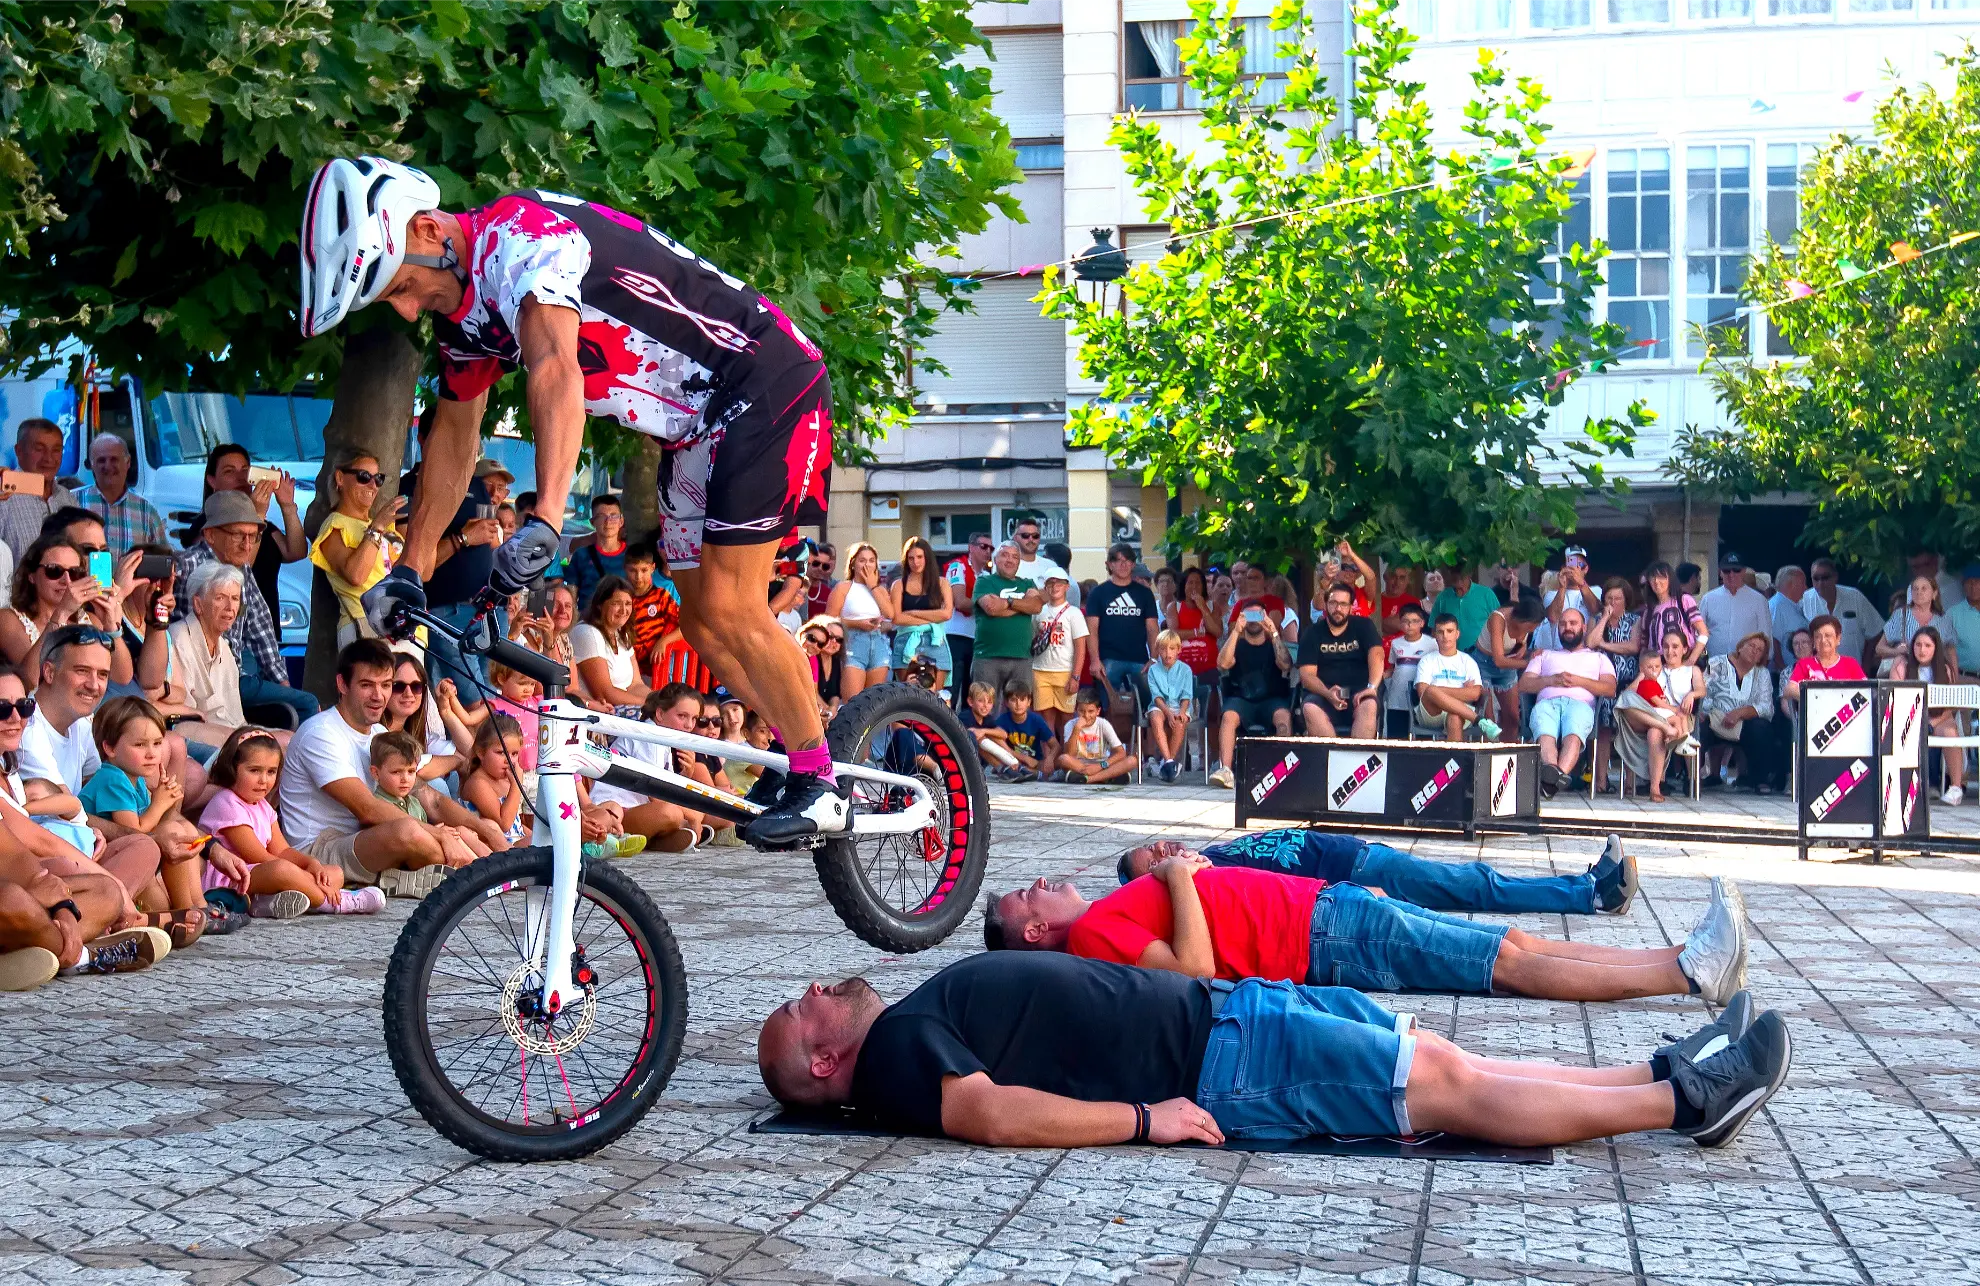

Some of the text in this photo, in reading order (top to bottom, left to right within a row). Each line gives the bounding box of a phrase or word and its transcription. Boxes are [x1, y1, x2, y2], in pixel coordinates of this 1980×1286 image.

[350, 249, 366, 284] RGBA
[800, 410, 820, 504] SPALL
[1106, 606, 1142, 617] adidas
[1810, 691, 1869, 753] RGBA
[1250, 750, 1300, 805] RGBA
[1331, 753, 1383, 808] RGBA
[1410, 757, 1461, 814] RGBA
[1492, 756, 1515, 813] RGBA
[1809, 758, 1870, 821] RGBA
[486, 879, 519, 898] RGBA
